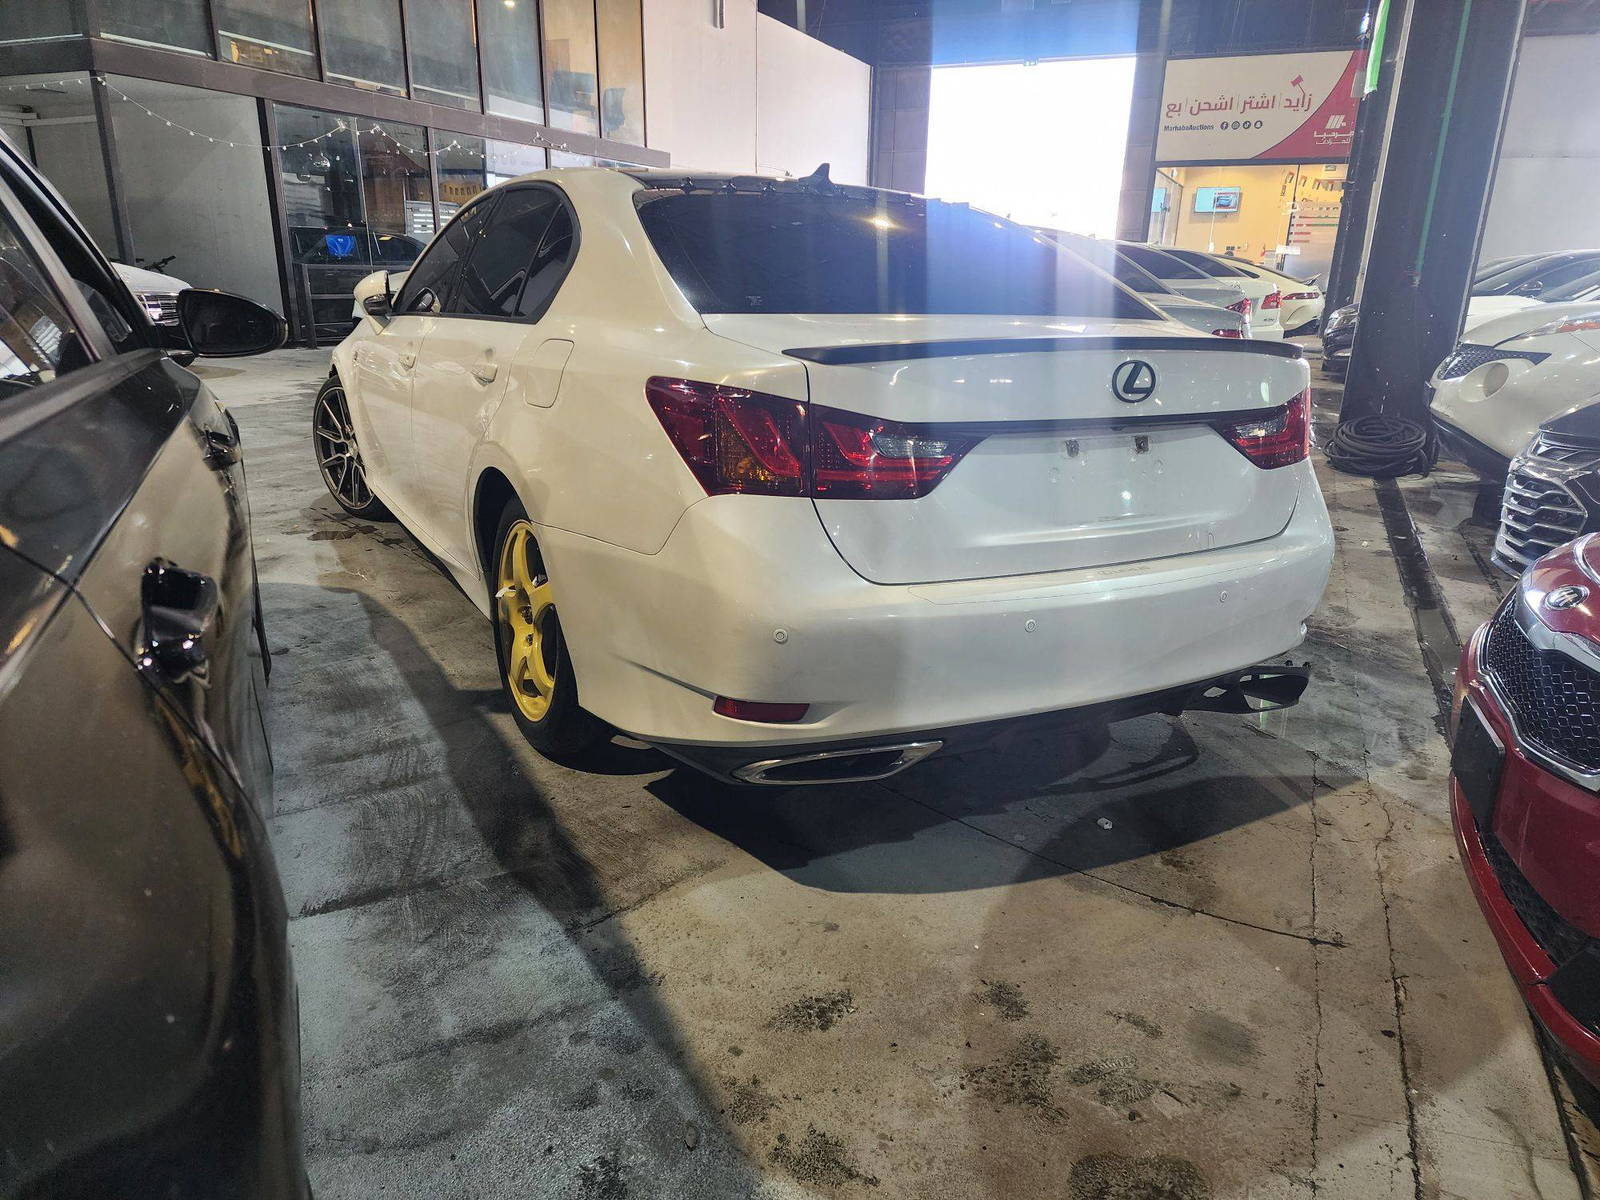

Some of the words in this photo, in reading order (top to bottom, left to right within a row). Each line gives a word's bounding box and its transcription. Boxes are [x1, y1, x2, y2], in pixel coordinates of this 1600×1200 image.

[1189, 94, 1234, 116] اشحن
[1240, 93, 1276, 114] اشتر
[1283, 84, 1312, 112] زايد
[1166, 102, 1183, 118] بع
